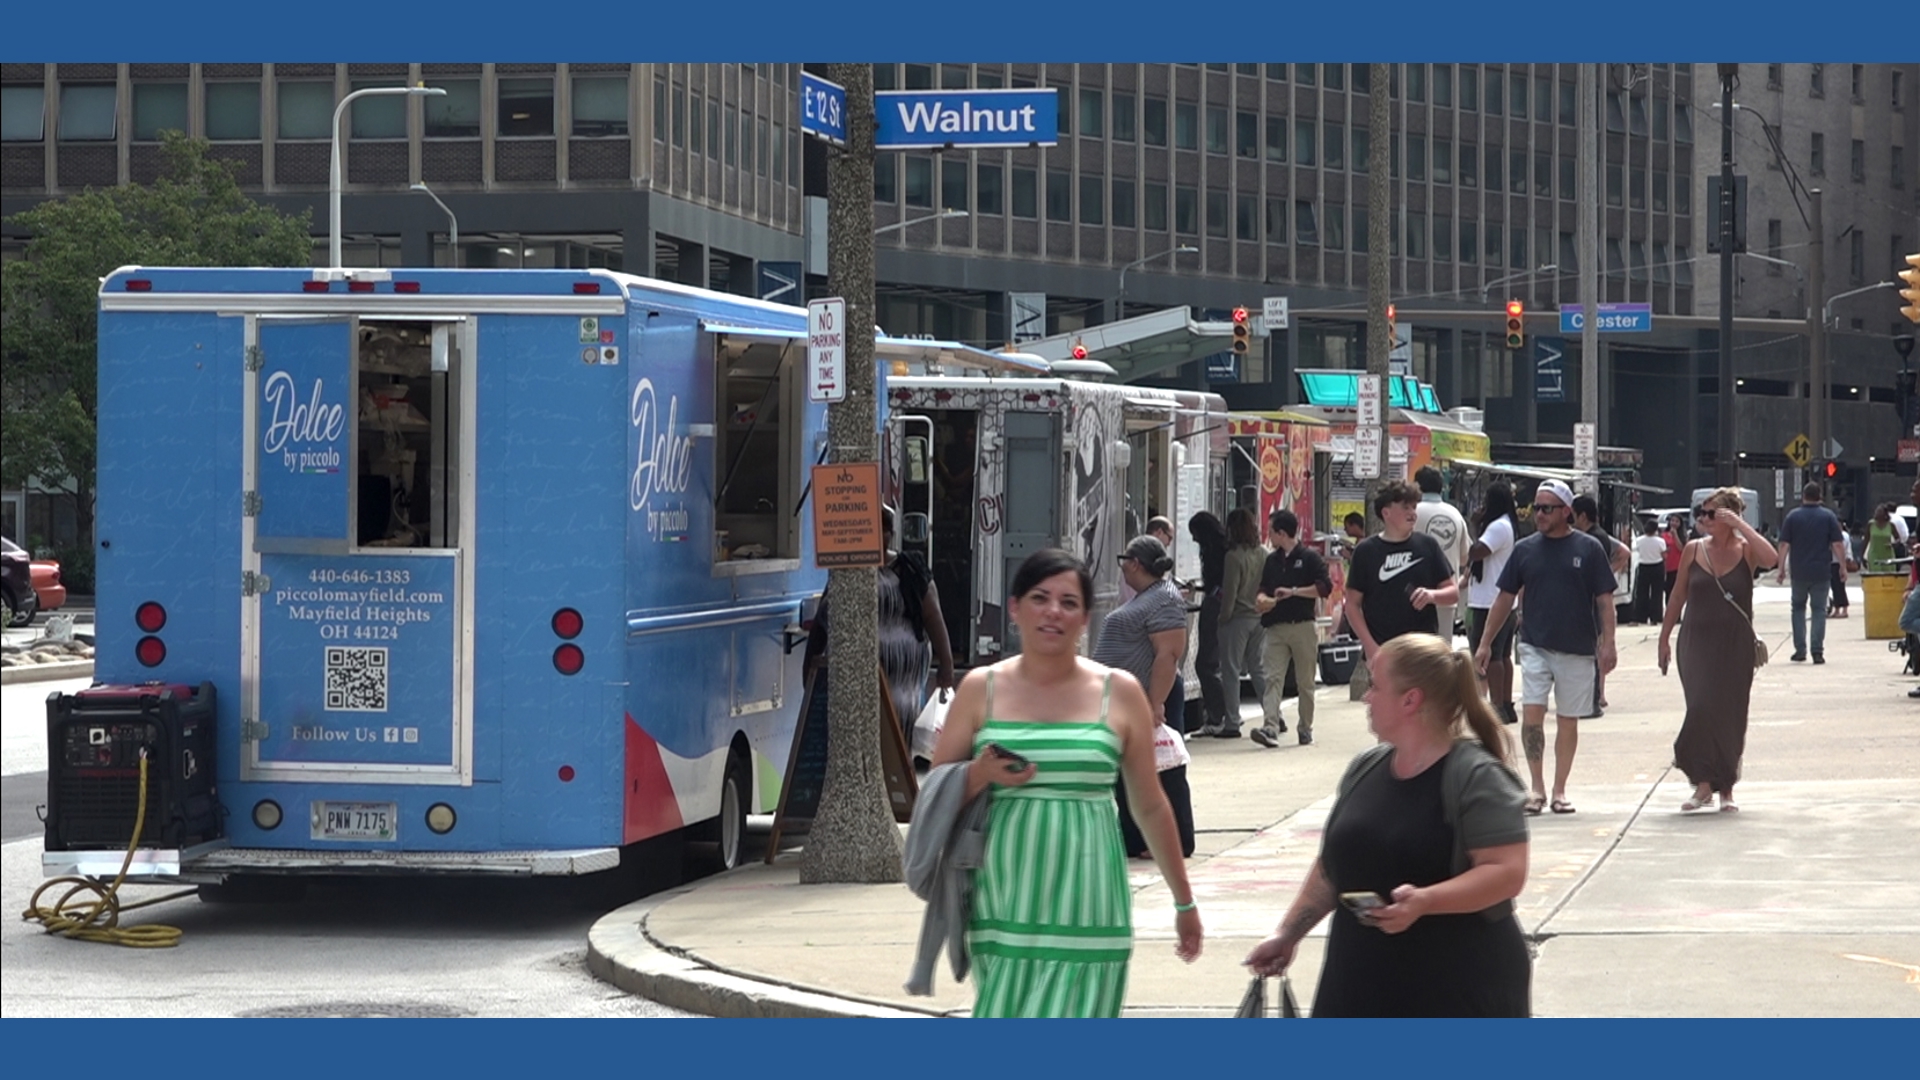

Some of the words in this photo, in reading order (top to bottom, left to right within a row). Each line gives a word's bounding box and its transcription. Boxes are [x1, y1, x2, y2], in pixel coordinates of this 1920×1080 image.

[816, 92, 827, 122] 12
[829, 97, 841, 128] St
[897, 101, 1036, 133] Walnut
[819, 312, 833, 331] NO
[1571, 313, 1639, 328] Cester
[811, 333, 841, 348] PARKING
[819, 350, 833, 364] ANY
[819, 367, 834, 380] TIME
[1363, 382, 1374, 391] NO
[264, 370, 346, 454] Dolce
[631, 377, 692, 511] Dolce
[284, 446, 298, 473] by
[300, 446, 340, 473] piccolo
[837, 473, 854, 484] NO
[824, 485, 867, 496] STOPPING
[825, 502, 868, 513] PARKING
[647, 502, 659, 542] by
[660, 502, 689, 541] piccolo
[822, 518, 872, 528] WEDNESDAYS
[1384, 552, 1413, 569] NIKE
[308, 569, 410, 584] 440-646-1383
[276, 587, 443, 606] piccolomayfield.com
[289, 605, 361, 624] Mayfield
[366, 607, 431, 626] Heights
[320, 624, 348, 639] OH
[353, 626, 398, 639] 44124
[292, 726, 350, 741] Follow
[354, 727, 377, 741] Us
[327, 811, 351, 829] PNW
[355, 812, 386, 830] 7175
